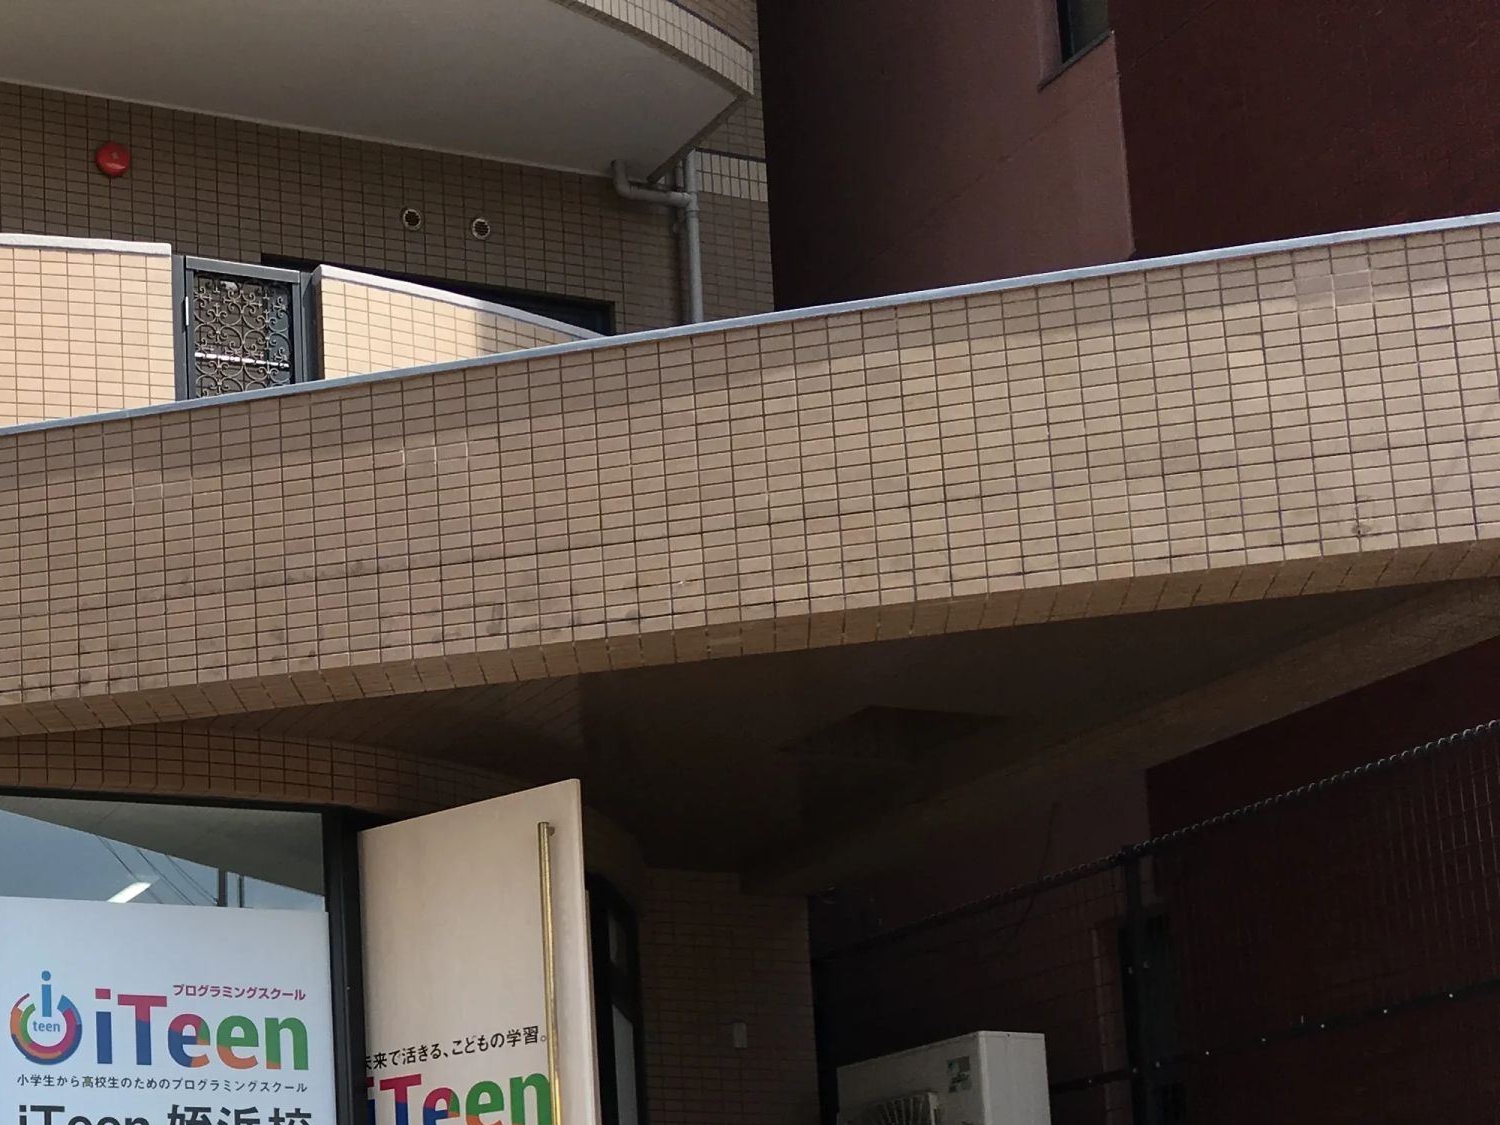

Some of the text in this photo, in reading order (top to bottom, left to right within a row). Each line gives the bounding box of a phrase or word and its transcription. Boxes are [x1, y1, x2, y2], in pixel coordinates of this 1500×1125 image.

[173, 984, 306, 1001] プログラミングスクール
[32, 1021, 61, 1033] teen
[95, 987, 309, 1071] iTeen
[16, 1073, 308, 1093] 小学生から高校生のためのプログラミングスクール
